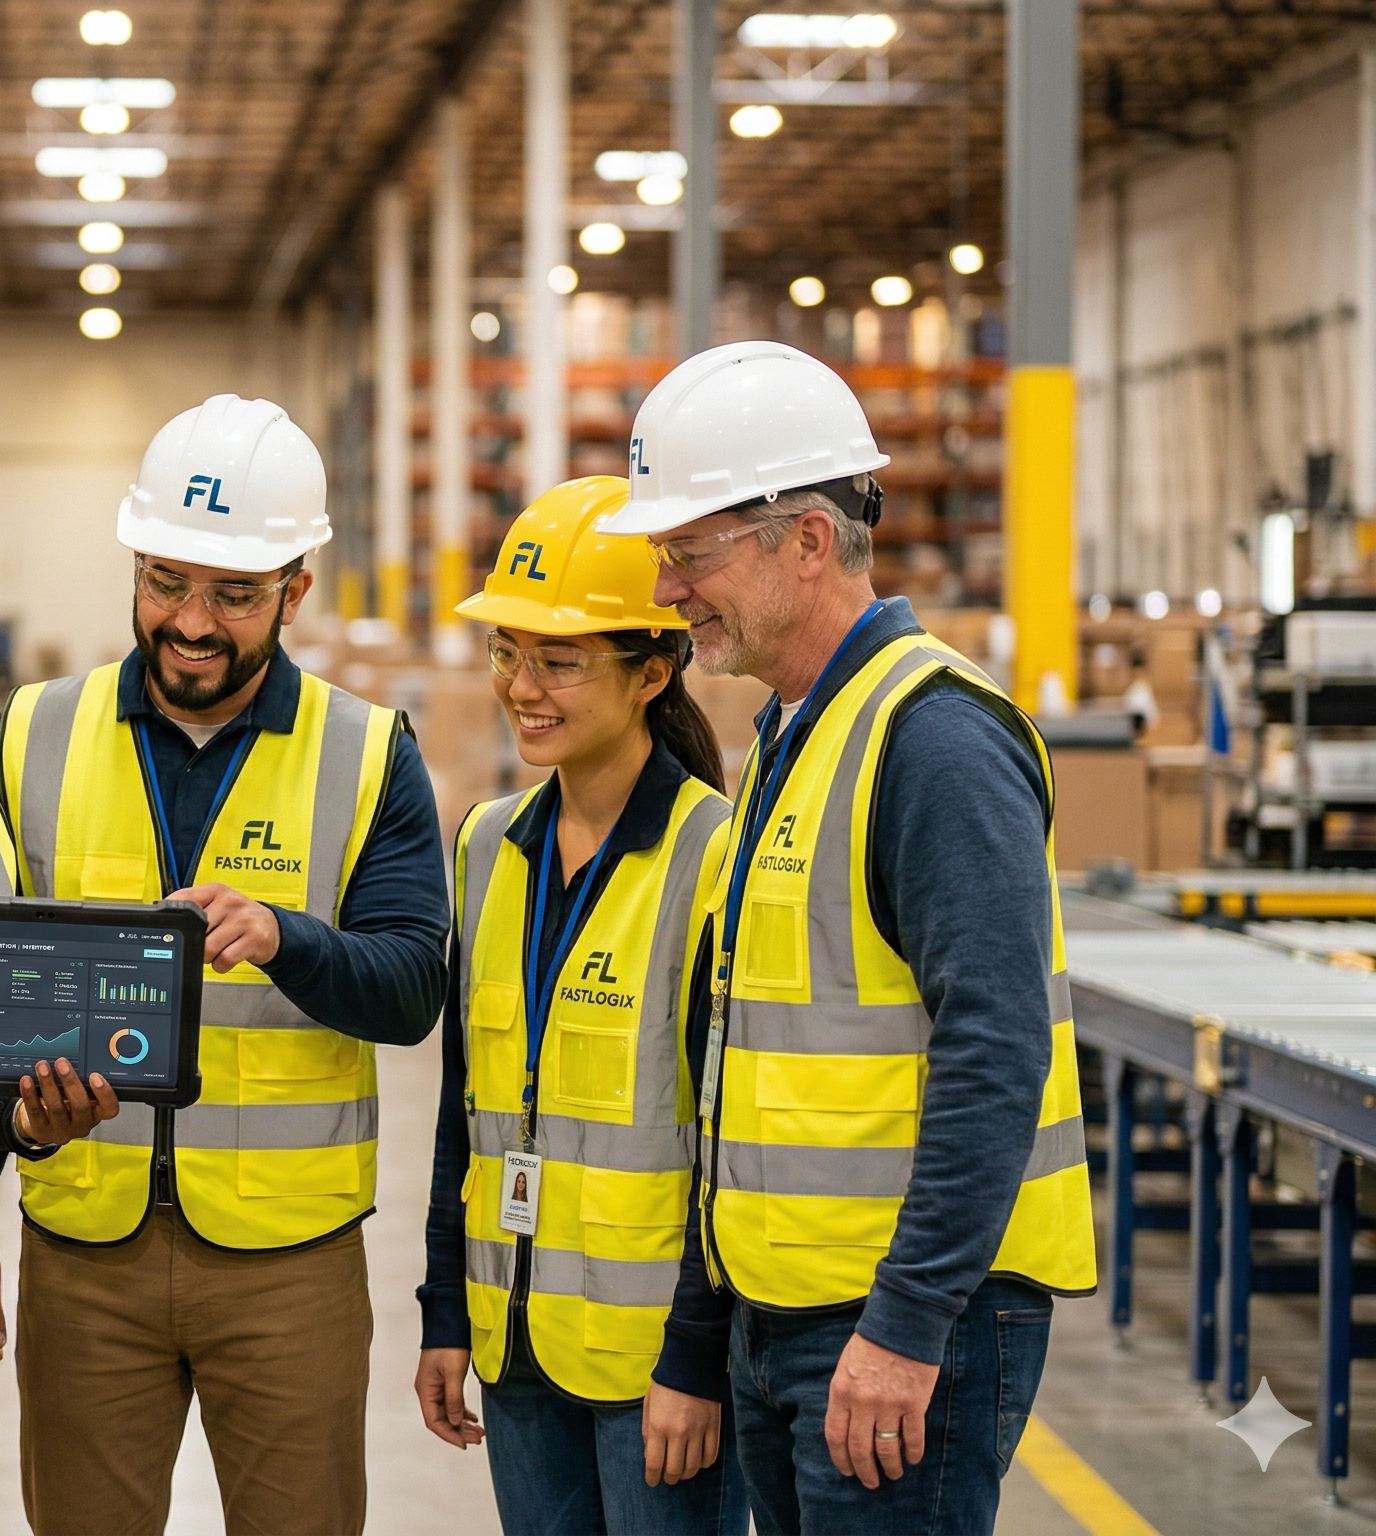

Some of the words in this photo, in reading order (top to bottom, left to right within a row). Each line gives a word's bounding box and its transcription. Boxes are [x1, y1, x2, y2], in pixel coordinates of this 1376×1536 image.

[183, 474, 230, 515] FL
[509, 541, 546, 581] FL
[240, 820, 282, 851] FL
[772, 814, 797, 849] FL
[214, 856, 302, 874] FASTLOGIX
[581, 951, 618, 984] FL
[559, 986, 636, 1009] FASTLOGIX
